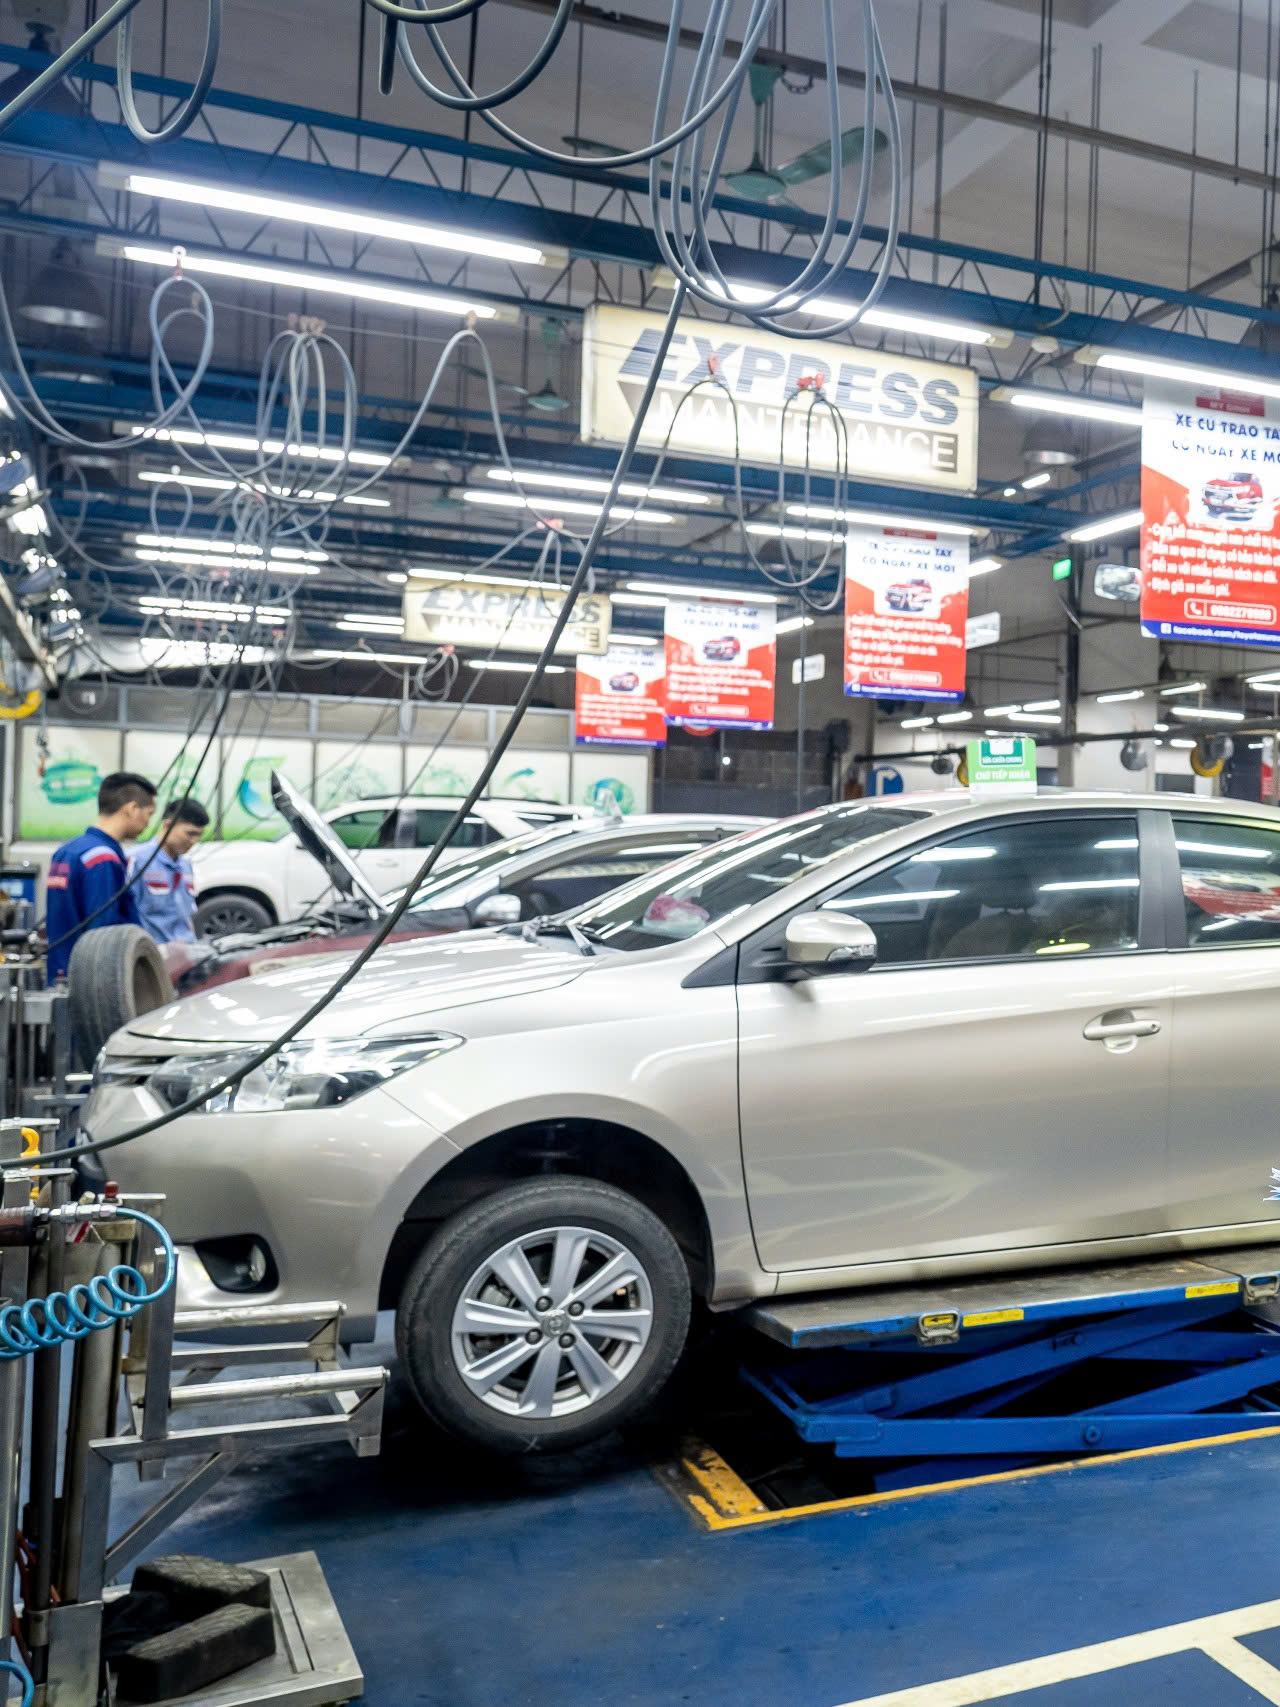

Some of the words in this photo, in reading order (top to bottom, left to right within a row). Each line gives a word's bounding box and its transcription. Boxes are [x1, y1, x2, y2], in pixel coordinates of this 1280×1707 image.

[619, 327, 960, 426] EXPRESS
[1175, 413, 1192, 428] XE
[1220, 421, 1259, 438] TRAO
[1240, 447, 1257, 461] XE
